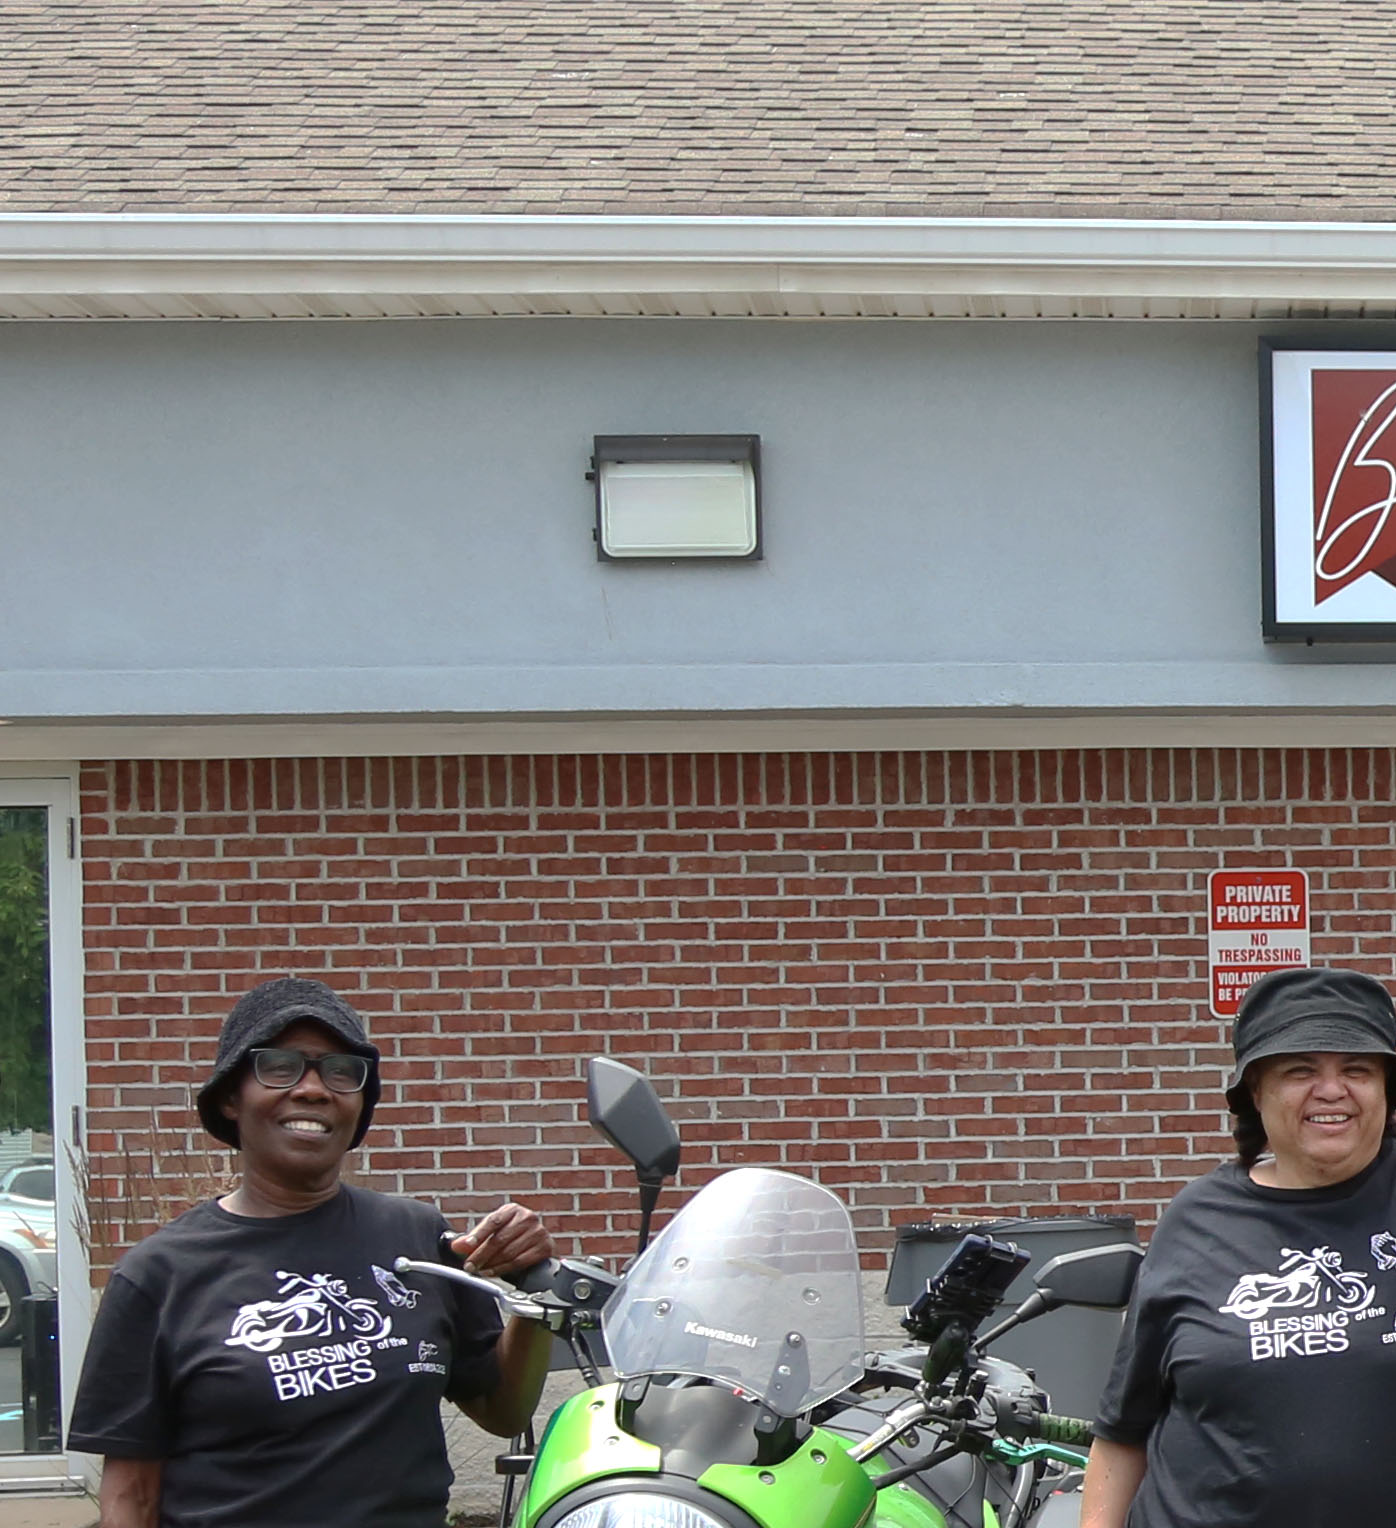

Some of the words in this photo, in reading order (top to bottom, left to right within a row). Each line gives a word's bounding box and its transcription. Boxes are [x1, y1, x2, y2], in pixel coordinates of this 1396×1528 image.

[1225, 885, 1292, 903] PRIVATE
[1216, 904, 1301, 923] PROPERTY
[1250, 932, 1268, 946] NO
[1217, 948, 1302, 963] TRESPASSING
[1218, 987, 1233, 1001] BE
[1250, 1311, 1349, 1336] BLESSING
[1355, 1309, 1368, 1322] of
[1368, 1306, 1386, 1317] the
[684, 1321, 758, 1349] Kawasaki
[1250, 1330, 1350, 1361] BIKES
[267, 1340, 371, 1374] BLESSING
[376, 1339, 389, 1351] of
[389, 1336, 409, 1348] the
[274, 1359, 377, 1401] BIKES
